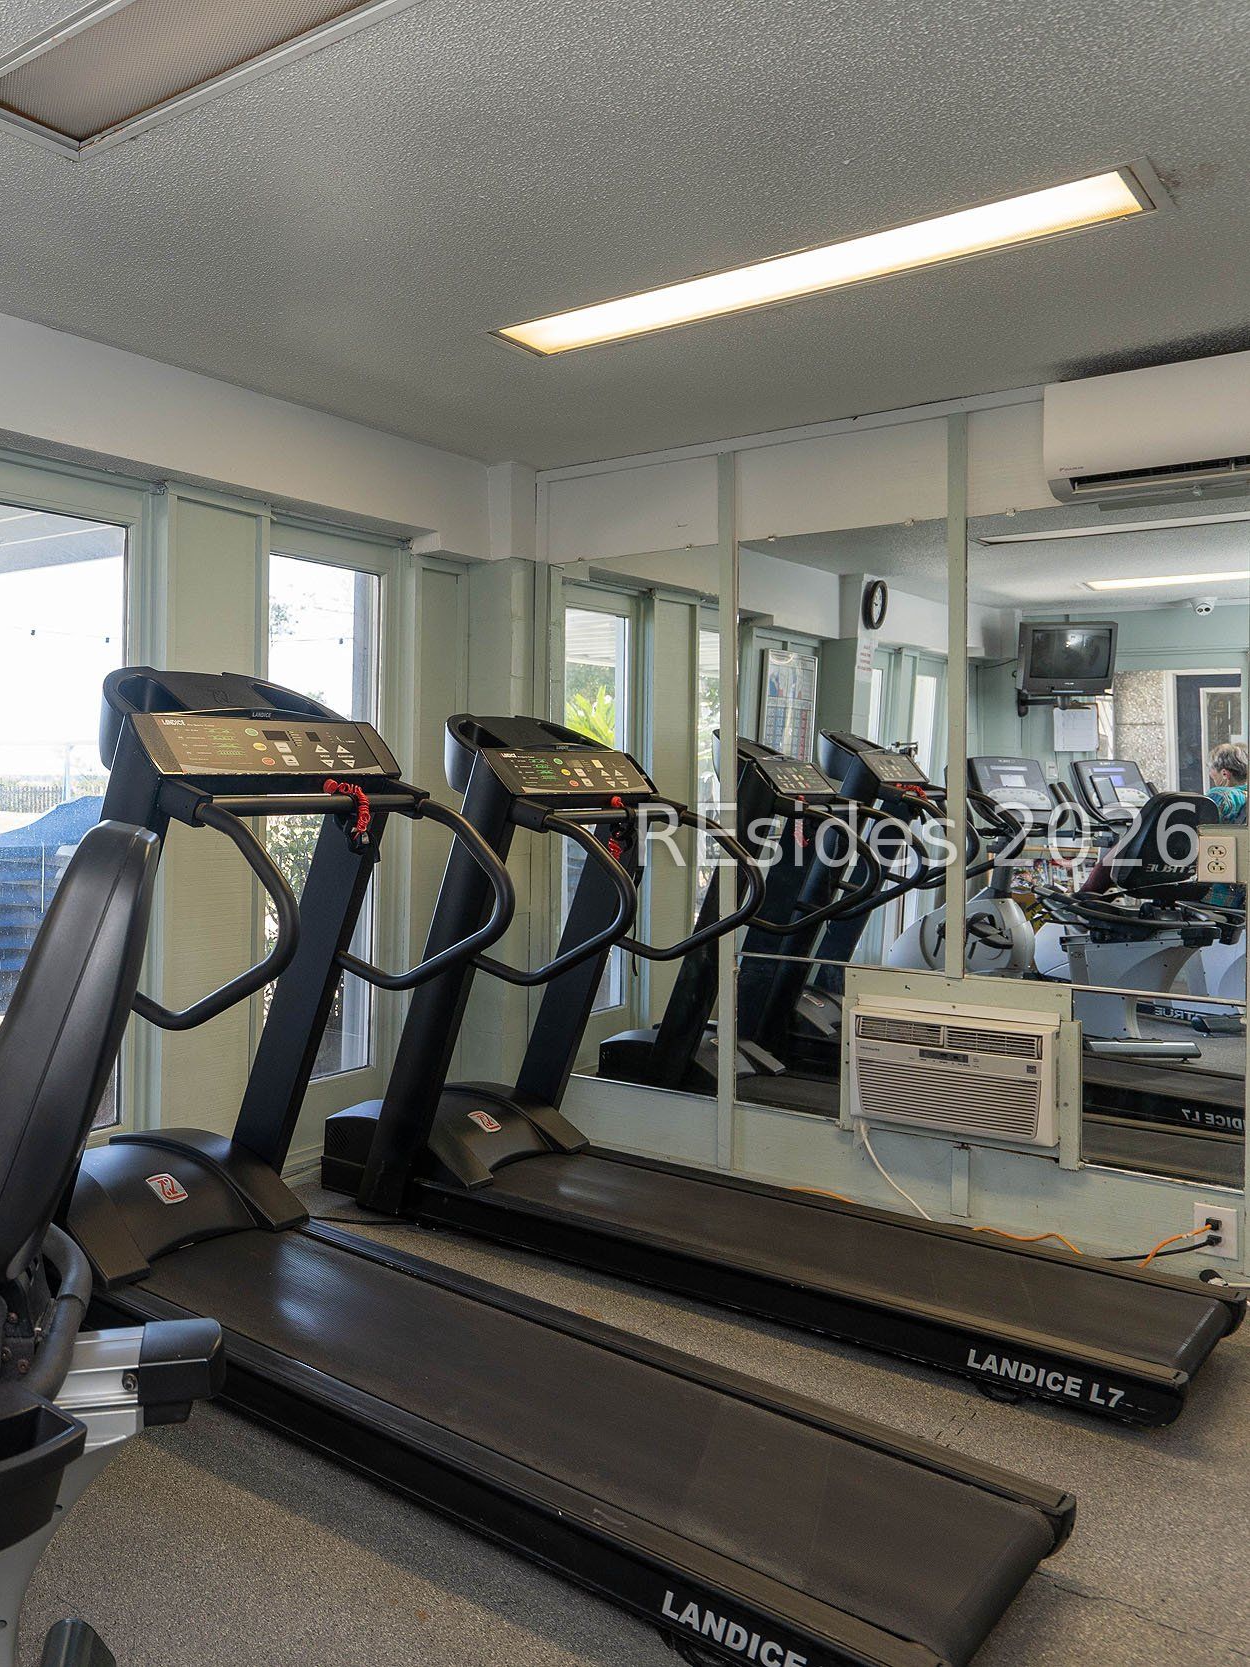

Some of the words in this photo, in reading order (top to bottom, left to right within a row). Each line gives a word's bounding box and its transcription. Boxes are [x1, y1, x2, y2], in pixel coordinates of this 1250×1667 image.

[966, 1348, 1082, 1398] LANDICE
[1089, 1382, 1125, 1409] L7
[661, 1591, 808, 1667] LANDICE
